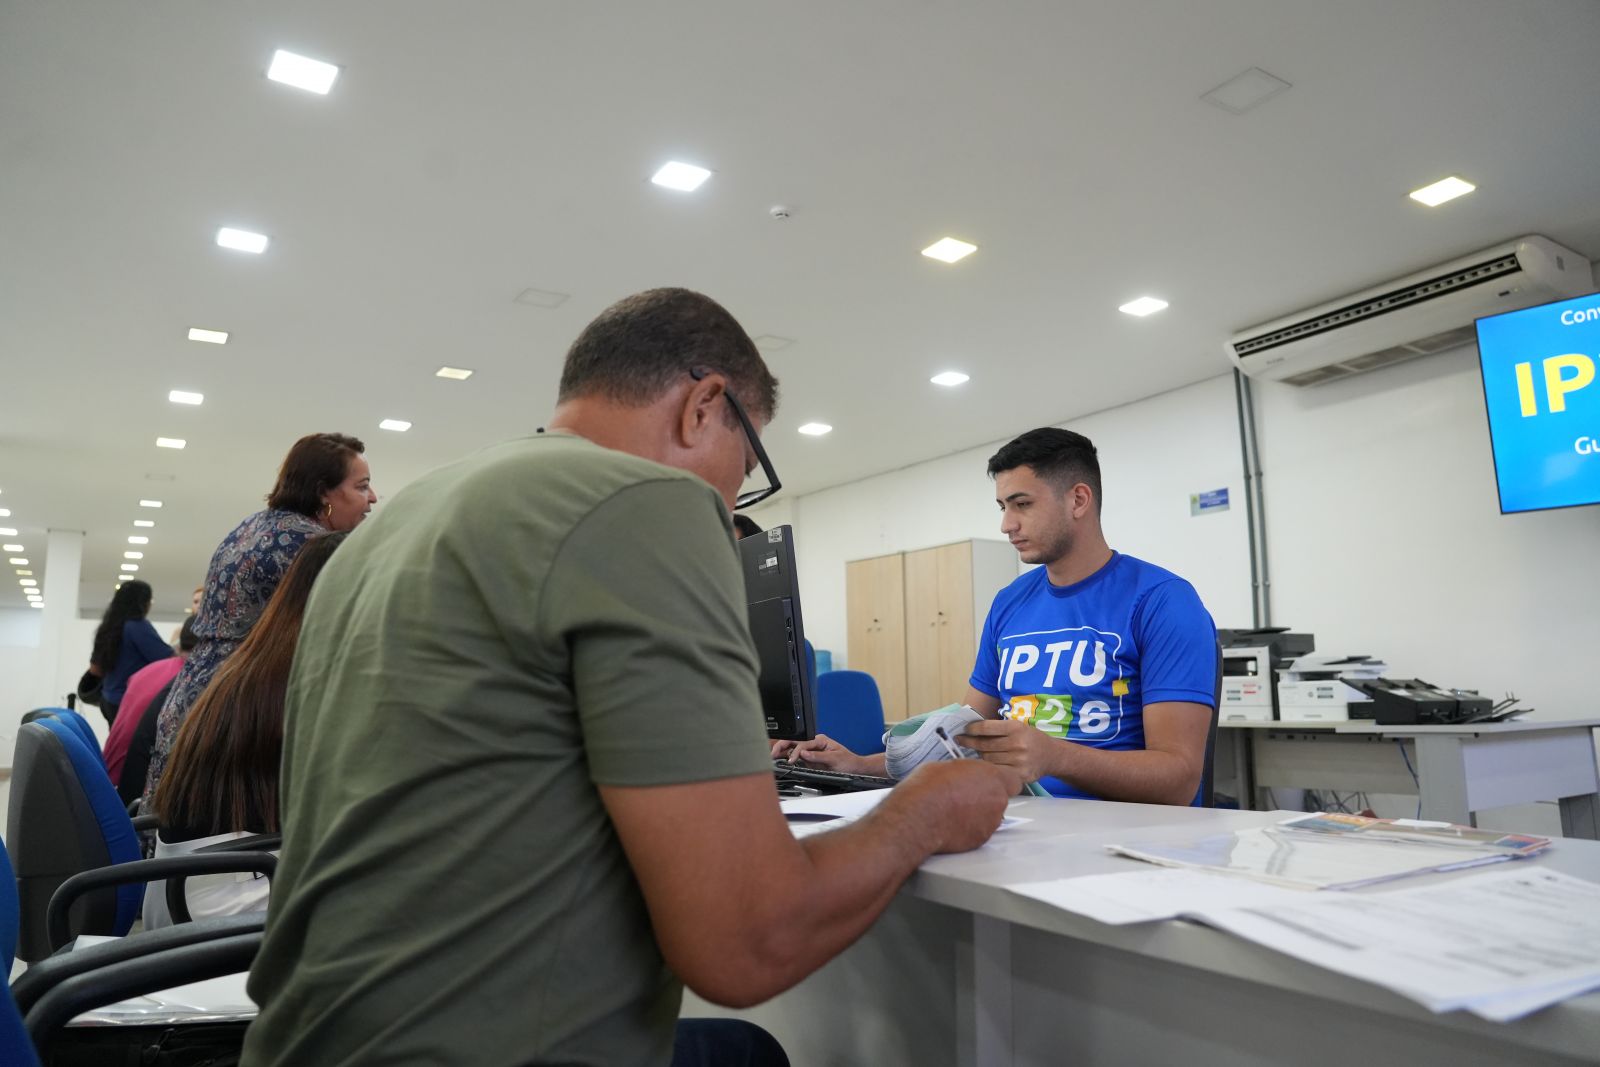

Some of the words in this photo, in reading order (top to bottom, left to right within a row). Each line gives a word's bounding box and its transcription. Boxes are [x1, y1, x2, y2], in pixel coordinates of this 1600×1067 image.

[1561, 307, 1600, 325] Con
[1515, 353, 1600, 417] IP
[999, 640, 1106, 690] IPTU
